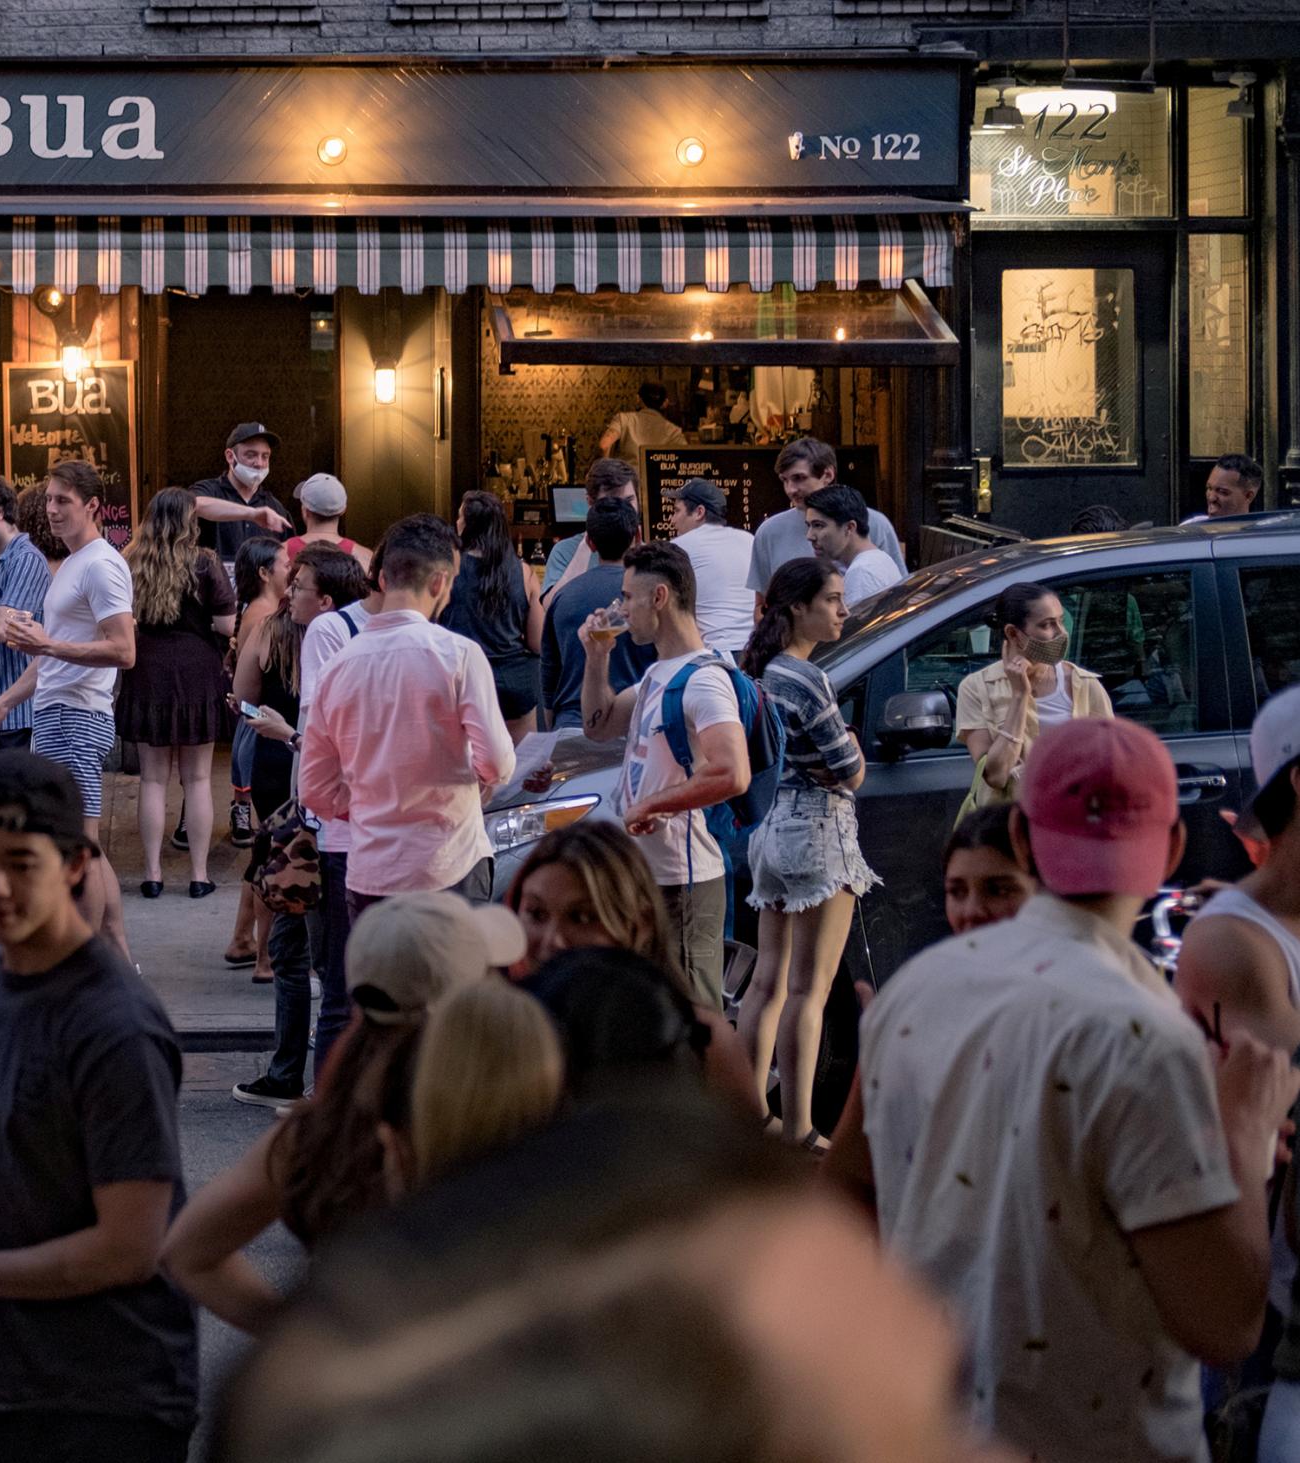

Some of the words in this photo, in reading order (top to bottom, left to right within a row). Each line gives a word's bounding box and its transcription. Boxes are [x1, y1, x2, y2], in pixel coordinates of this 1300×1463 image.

[1031, 102, 1110, 141] 122
[871, 133, 921, 161] 122
[1041, 144, 1141, 180] Mark's
[1025, 175, 1100, 207] Place
[28, 376, 112, 415] Bua
[660, 462, 677, 470] BUA
[679, 462, 712, 471] BURGER
[660, 479, 685, 487] FRIED
[743, 479, 752, 487] 10
